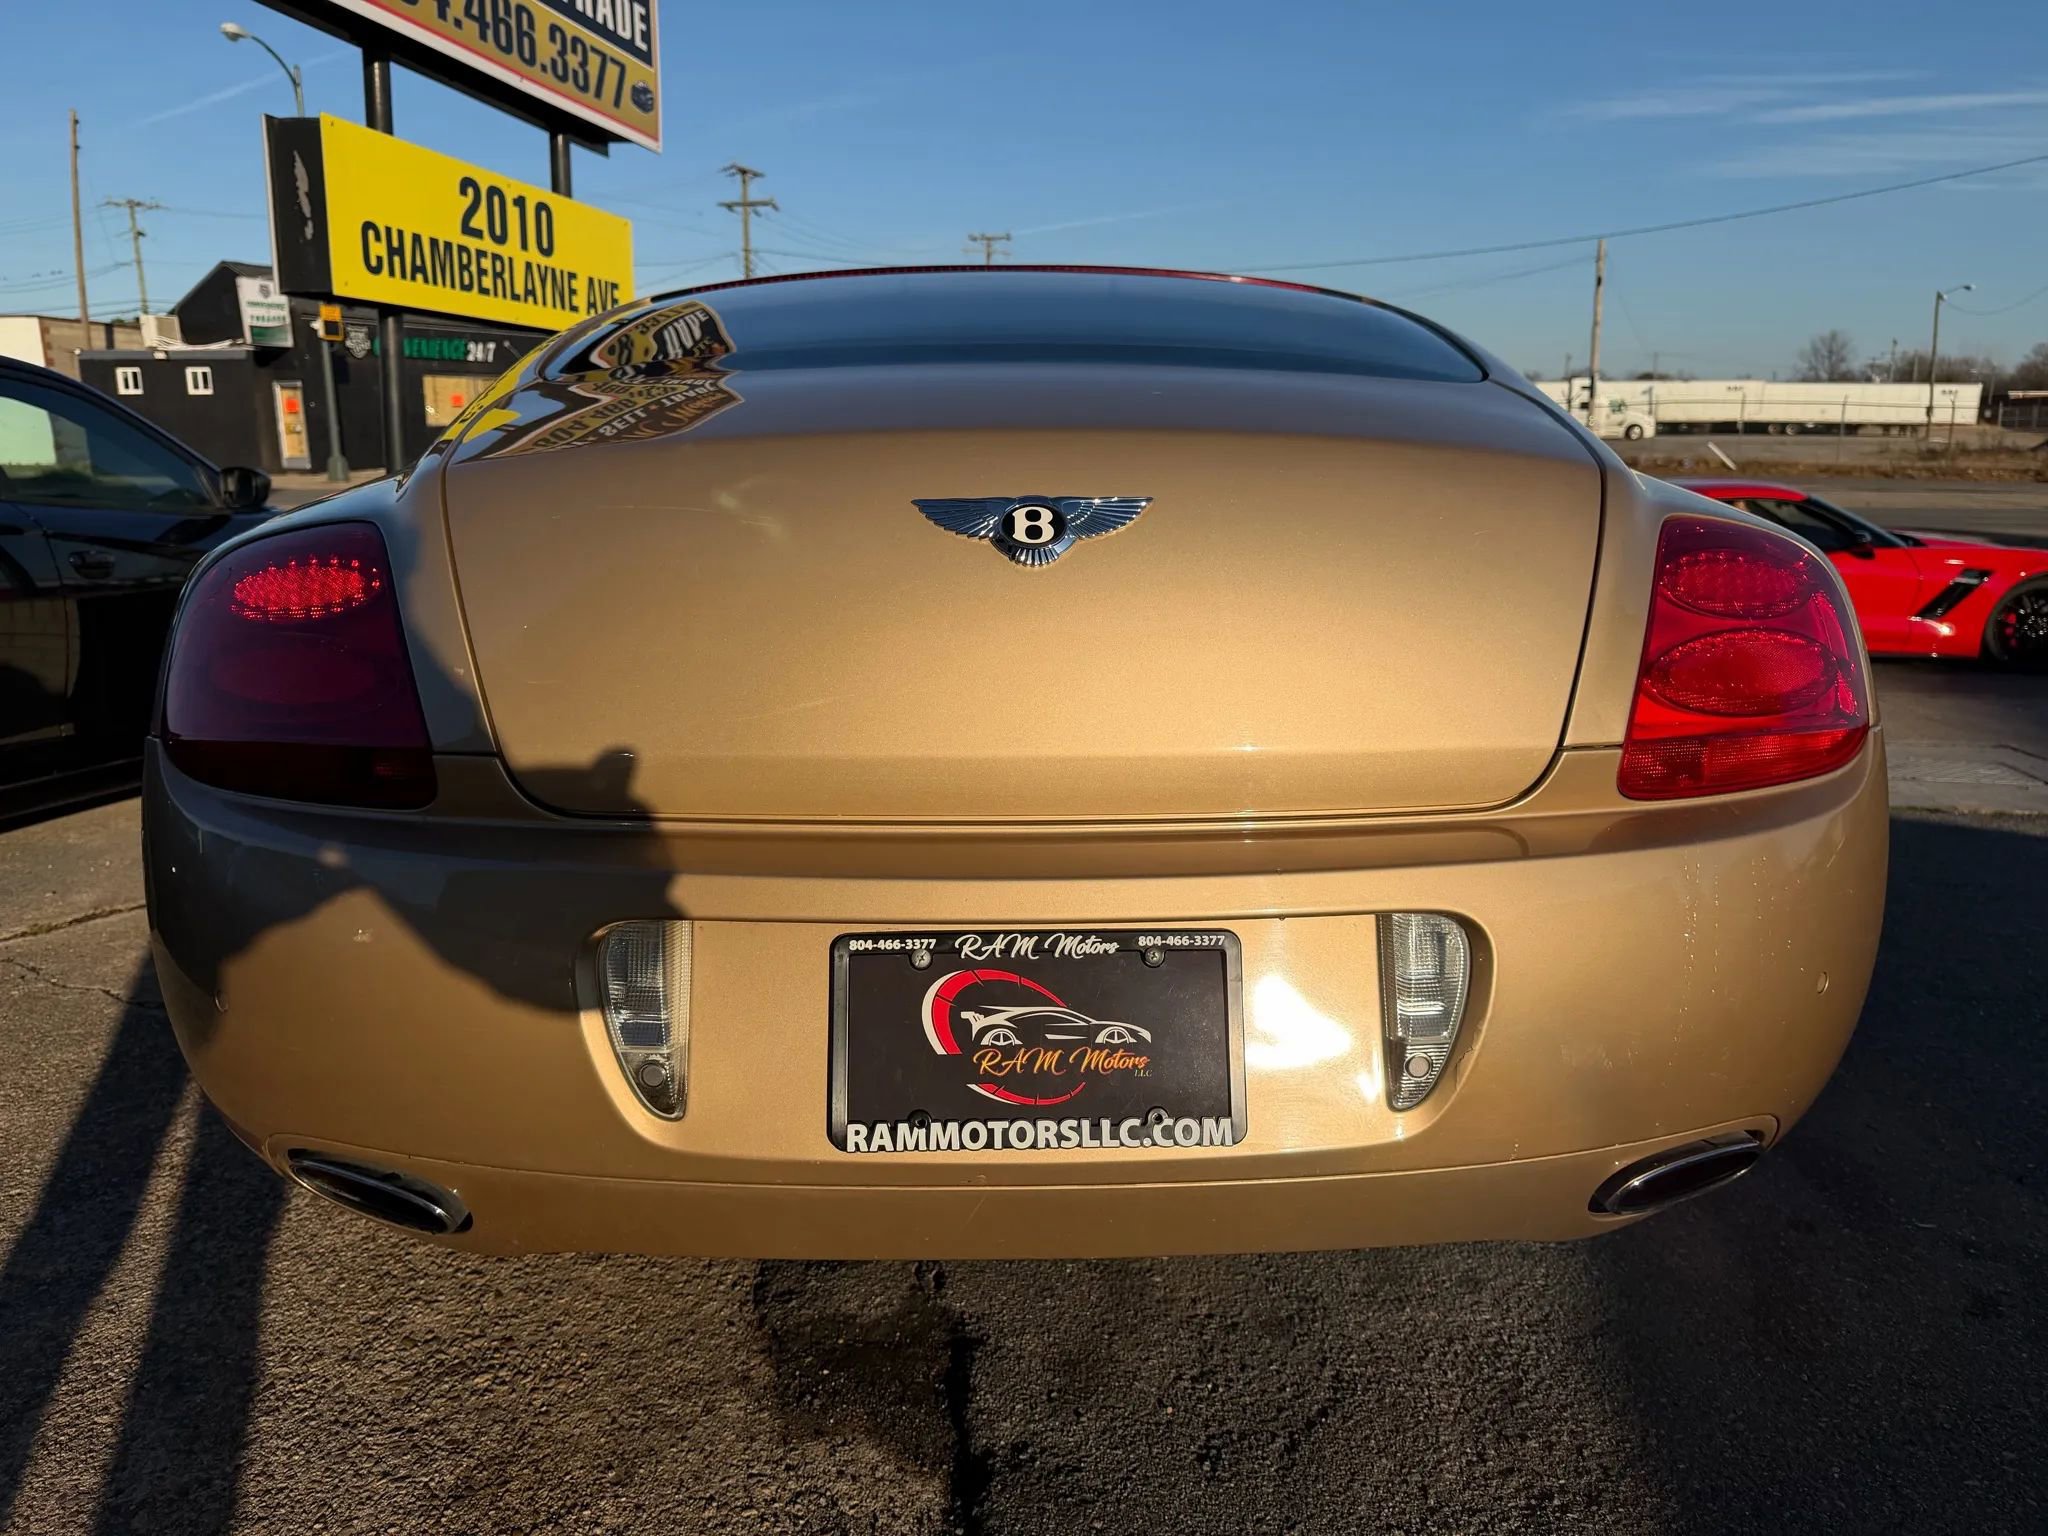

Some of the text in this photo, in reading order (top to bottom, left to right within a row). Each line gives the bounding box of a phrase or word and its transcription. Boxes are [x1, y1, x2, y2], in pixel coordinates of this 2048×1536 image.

[563, 0, 649, 52] ADE
[403, 0, 626, 109] .466.3377
[459, 176, 554, 258] 2010
[361, 221, 580, 313] CHAMBERLAYNE
[1012, 506, 1054, 543] B
[849, 933, 1225, 961] 804-466-3377 RAM Motors 804-466-3377
[973, 1046, 1151, 1076] RAM Motors
[847, 1117, 1234, 1152] RAMMOTORSLLC.COM
